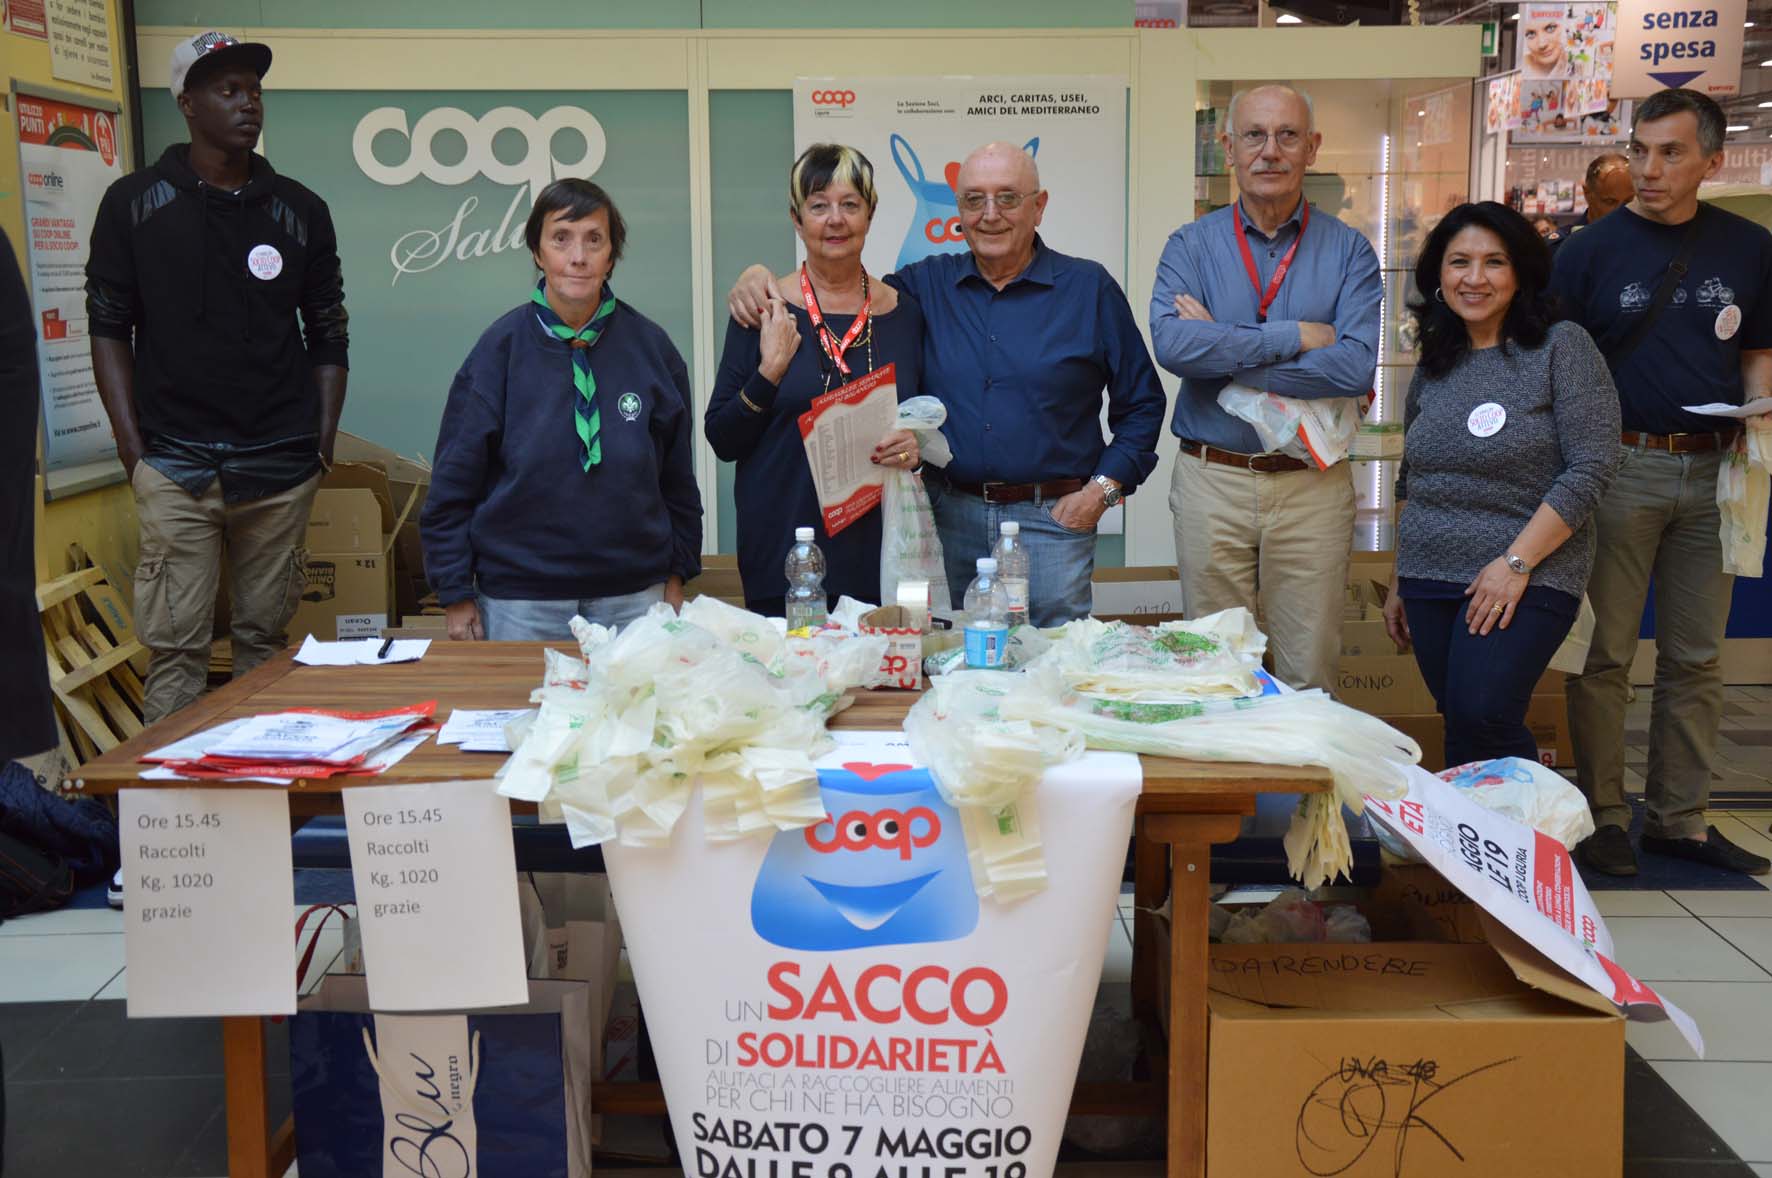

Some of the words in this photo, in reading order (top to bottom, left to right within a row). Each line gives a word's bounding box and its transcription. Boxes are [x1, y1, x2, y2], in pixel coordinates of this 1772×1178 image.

[1643, 9, 1718, 30] senza
[1640, 39, 1716, 65] spesa
[812, 90, 856, 108] coop
[979, 95, 1007, 104] ARCI,
[1010, 94, 1057, 103] CARITAS,
[1061, 94, 1088, 103] USEI,
[967, 107, 996, 115] AMICI
[1000, 107, 1018, 115] DEL
[1021, 106, 1100, 115] MEDITERRANEO
[21, 116, 45, 134] PUNTI
[352, 105, 607, 207] coop
[925, 217, 966, 244] co
[364, 559, 376, 569] 12
[137, 814, 169, 830] Ore
[174, 813, 221, 829] 15.45
[363, 810, 393, 826] Ore
[399, 808, 443, 825] 15.45
[804, 806, 941, 860] coop
[139, 843, 206, 860] Raccolti
[367, 839, 430, 857] Raccolti
[1483, 839, 1509, 868] 19
[1514, 847, 1528, 883] LIGURIA
[140, 875, 166, 892] Kg.
[172, 873, 213, 889] 1020
[370, 871, 394, 889] Kg.
[400, 868, 439, 885] 1020
[141, 904, 192, 922] grazie
[374, 899, 421, 918] grazie
[725, 1000, 763, 1023] UN
[767, 961, 1008, 1027] SACCO
[705, 1039, 728, 1066] DI
[737, 1028, 1006, 1074] SOLIDARIETÀ
[706, 1070, 776, 1089] AIUTACI
[782, 1071, 797, 1088] A
[802, 1073, 924, 1094] RACCOGLIERE
[931, 1079, 1014, 1096] ALIMENTI
[706, 1086, 741, 1110] PER
[750, 1089, 793, 1112] CHI
[803, 1092, 835, 1115] NE
[845, 1094, 885, 1117] HA
[893, 1095, 1014, 1119] BISOGNO
[692, 1112, 829, 1154] SABATO
[841, 1126, 863, 1155] 7
[875, 1125, 1032, 1160] MAGGIO
